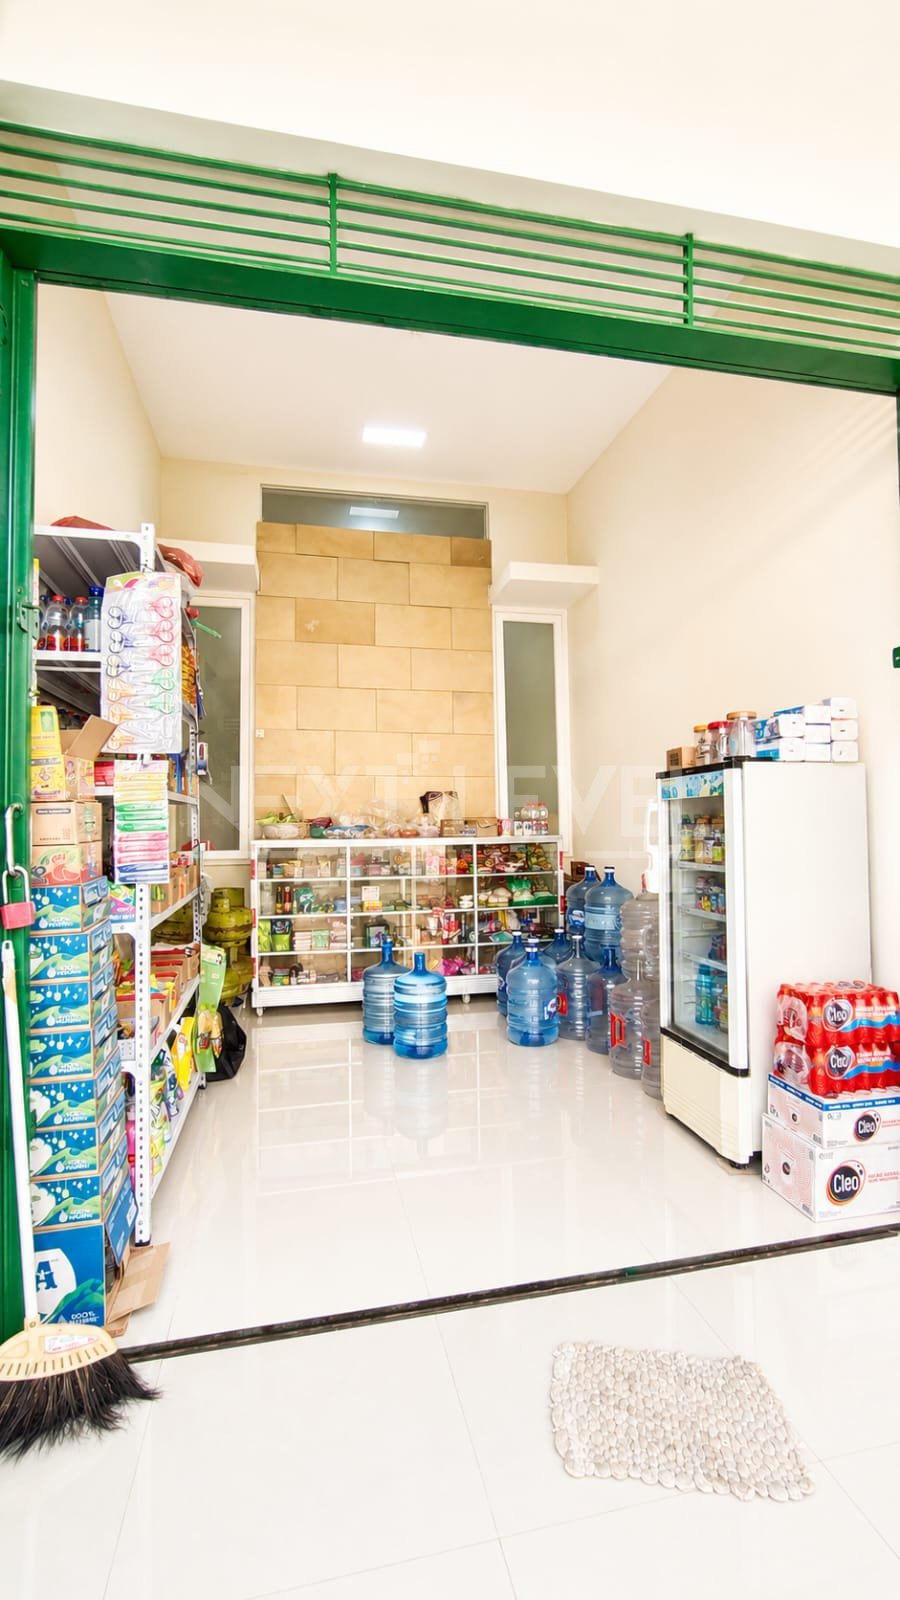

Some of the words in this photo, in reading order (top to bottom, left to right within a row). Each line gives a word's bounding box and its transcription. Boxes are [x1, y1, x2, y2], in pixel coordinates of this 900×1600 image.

[828, 1006, 848, 1022] Cleo
[858, 1119, 876, 1134] Cleo
[833, 1174, 859, 1193] Cleo
